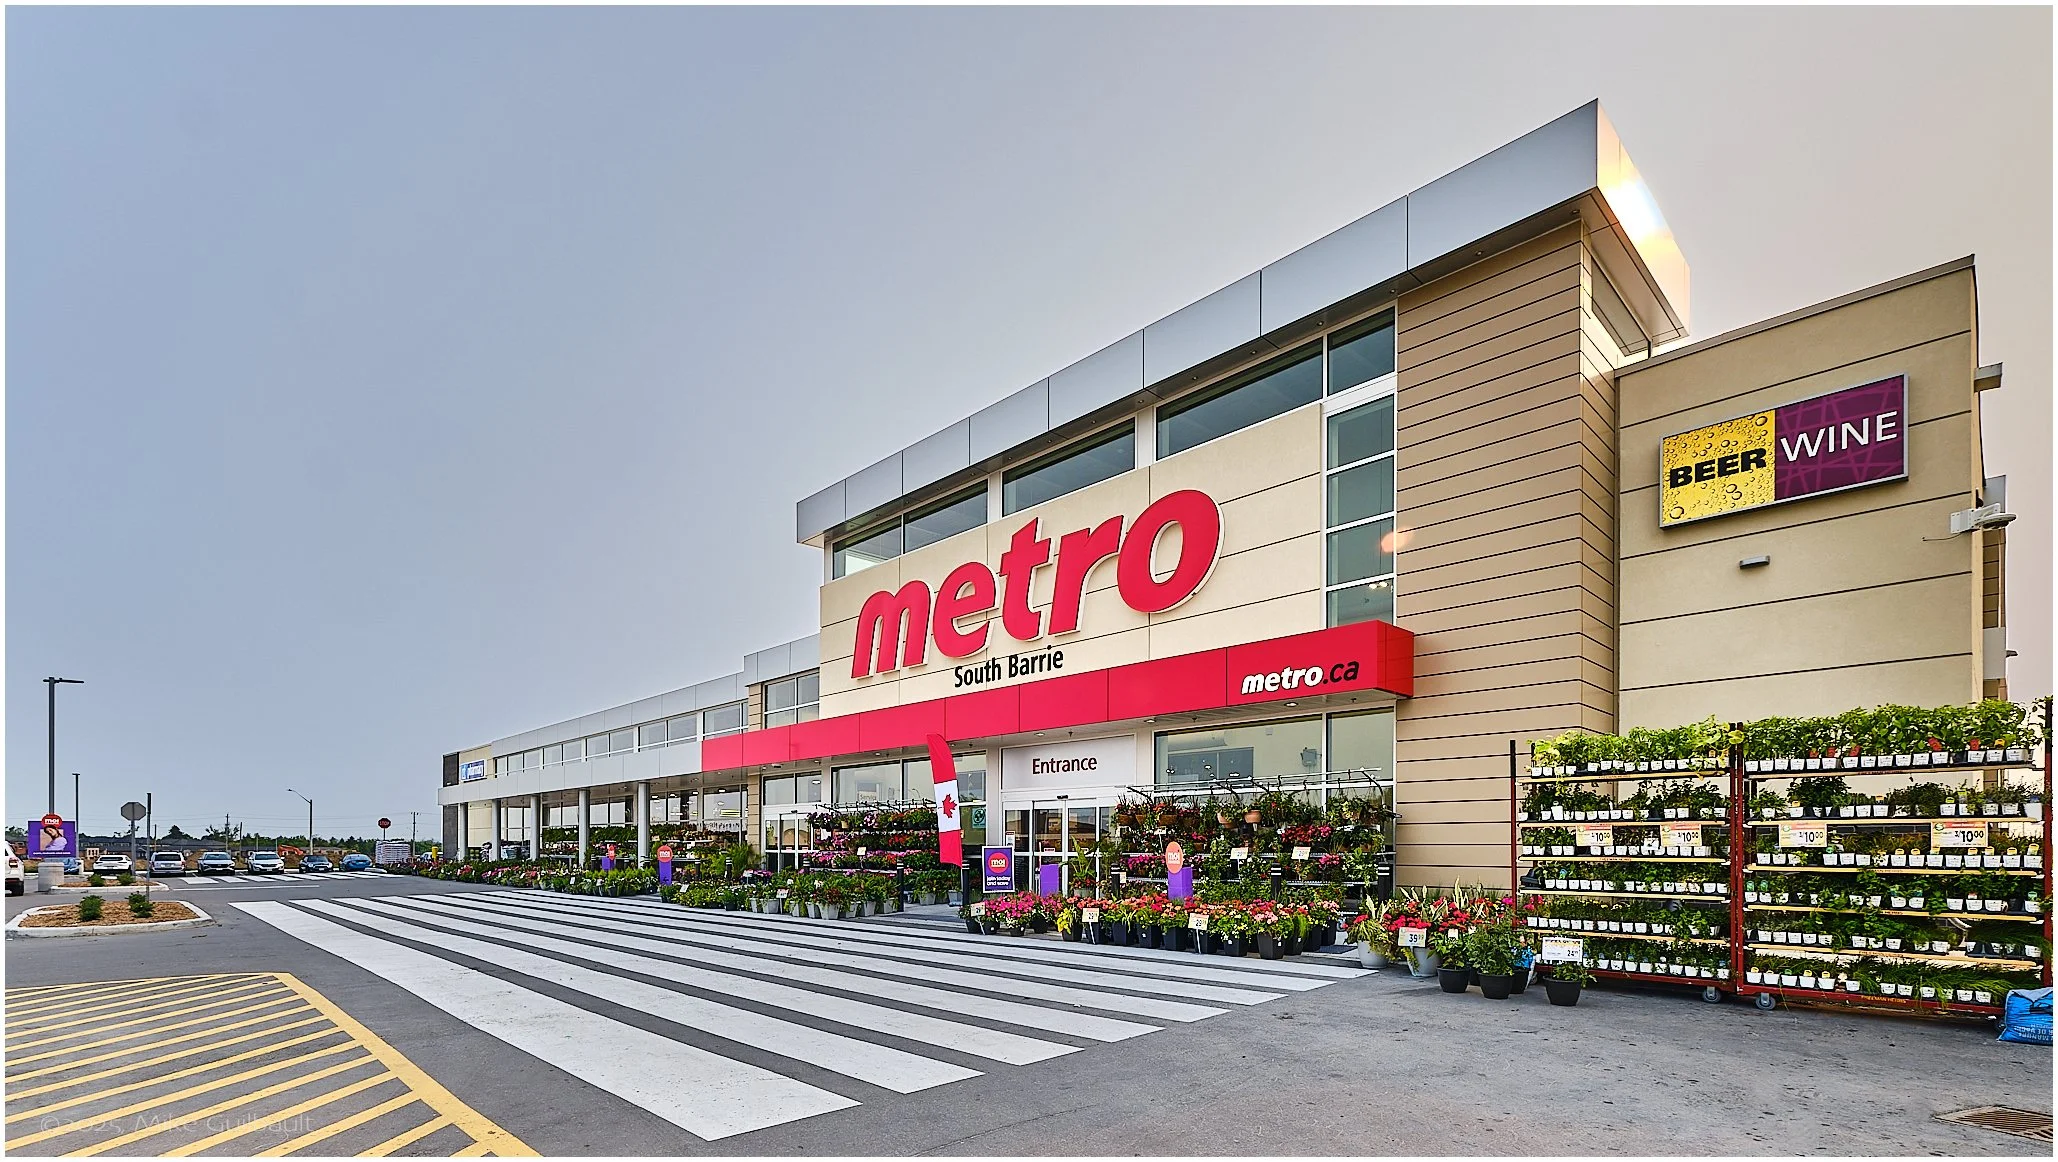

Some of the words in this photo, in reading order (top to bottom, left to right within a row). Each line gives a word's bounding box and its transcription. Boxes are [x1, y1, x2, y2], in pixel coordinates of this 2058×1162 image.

[1669, 448, 1767, 489] BEER
[1780, 411, 1898, 462] WINE
[851, 489, 1221, 680] metro
[954, 658, 1002, 688] South
[1009, 645, 1064, 679] Barrie
[1241, 661, 1360, 695] metro.ca
[1032, 757, 1098, 774] Entrance
[990, 858, 1006, 868] moi
